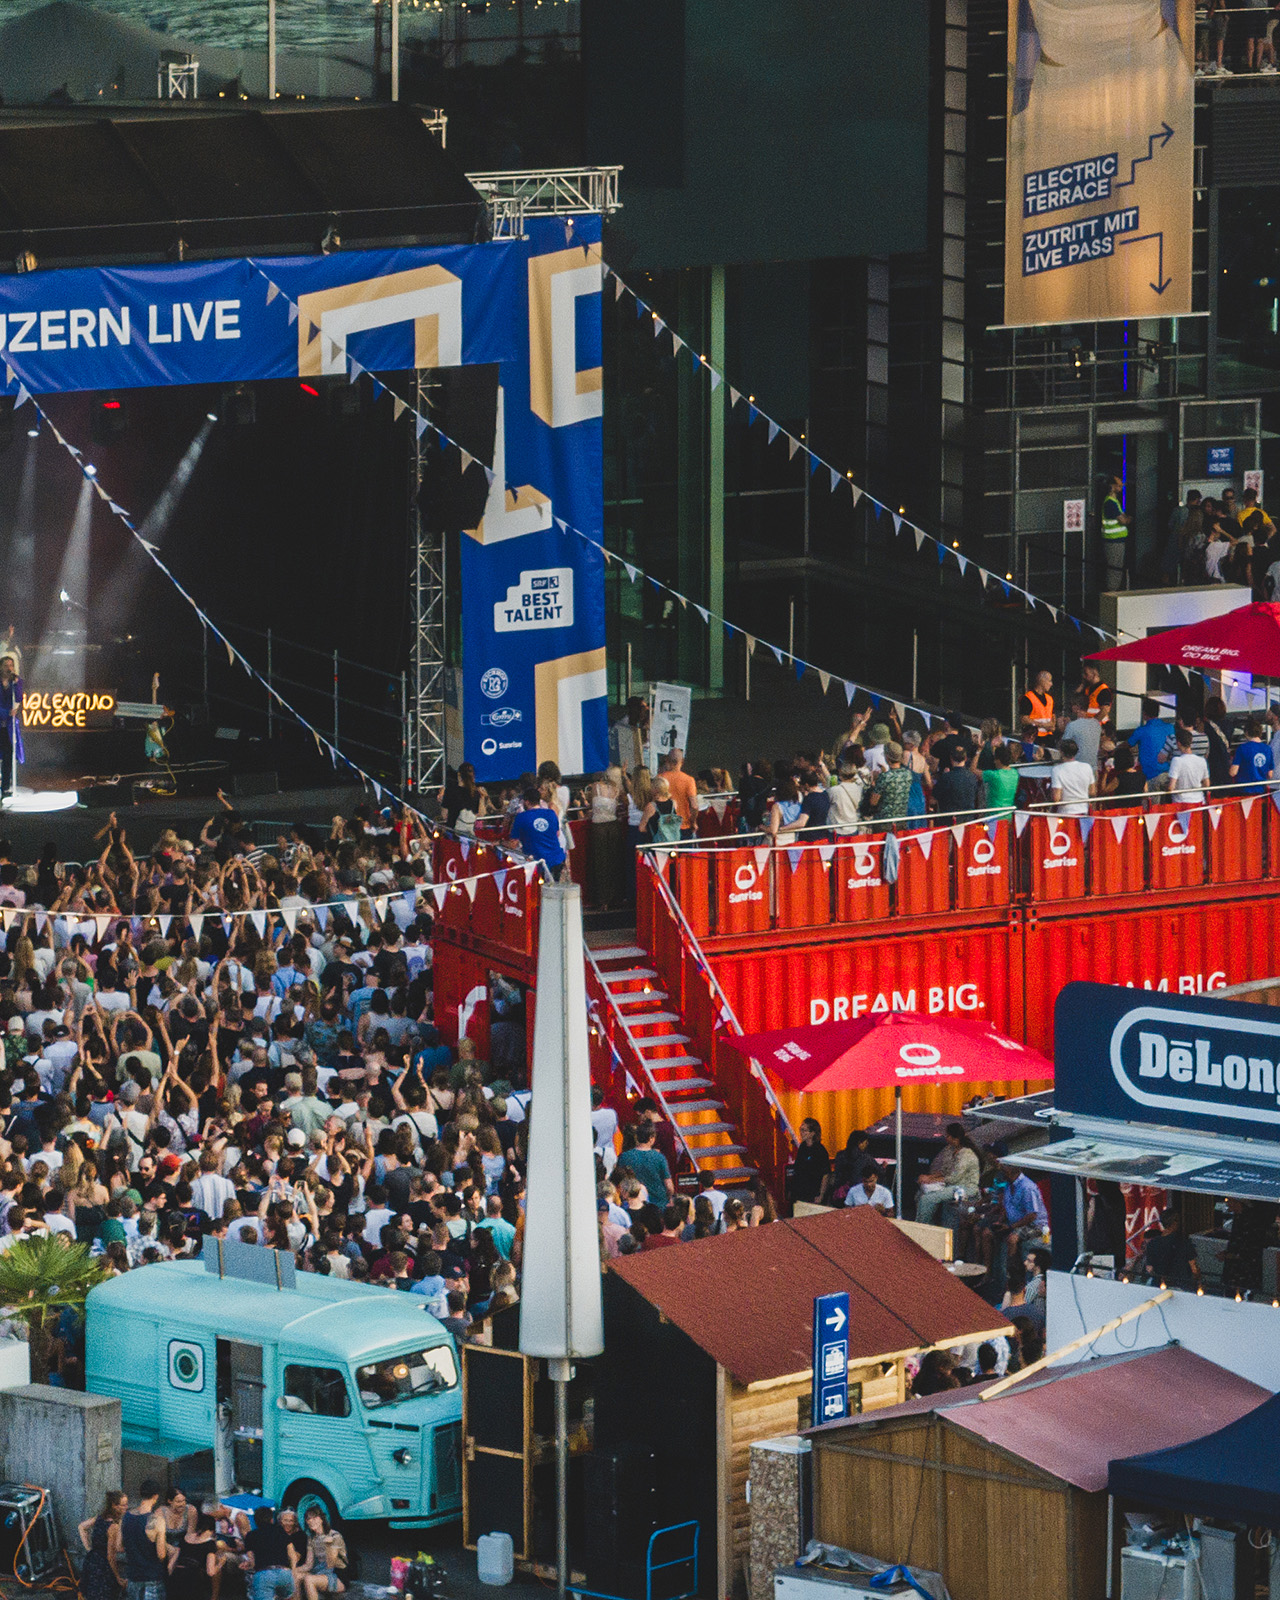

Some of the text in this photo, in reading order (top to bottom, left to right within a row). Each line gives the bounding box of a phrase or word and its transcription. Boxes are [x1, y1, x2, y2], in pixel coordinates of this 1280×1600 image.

[1026, 157, 1115, 194] ELECTRIC
[1026, 179, 1109, 213] TERRACE
[1026, 210, 1137, 252] ZUTRITT MIT
[1026, 236, 1113, 273] LIVE PASS
[148, 300, 241, 344] LIVE
[522, 592, 559, 607] BEST
[504, 606, 563, 622] TALENT
[1181, 645, 1219, 654] DREAM
[499, 741, 523, 749] Sunrise
[1162, 844, 1196, 856] Sunrise
[967, 864, 1001, 876] Sunrise
[1043, 856, 1077, 869] Sunrise
[847, 877, 882, 889] Sunrise
[729, 890, 763, 903] Sunrise
[810, 984, 985, 1025] DREAM BIG.
[895, 1065, 965, 1077] Sunrise
[1139, 1032, 1280, 1106] DēLon
